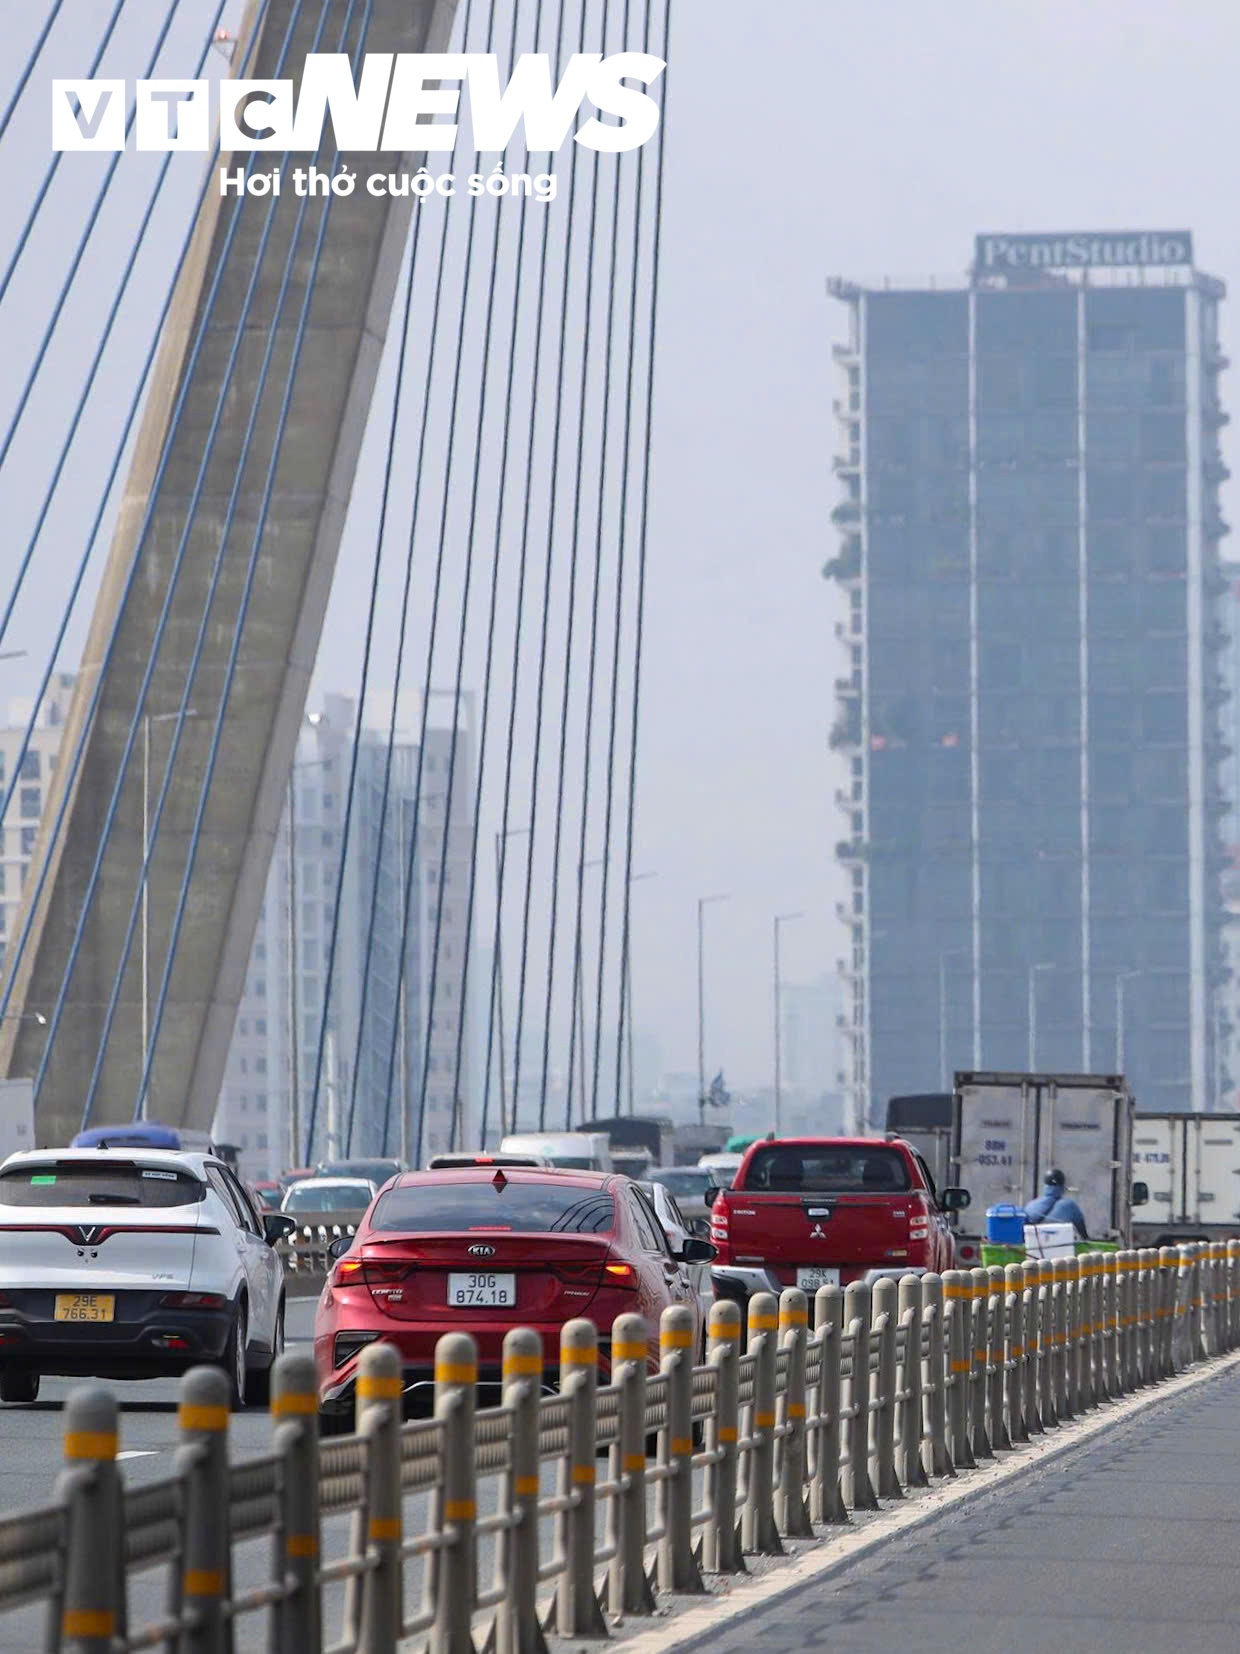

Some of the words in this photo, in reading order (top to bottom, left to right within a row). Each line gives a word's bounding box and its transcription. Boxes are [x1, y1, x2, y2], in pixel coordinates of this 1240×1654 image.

[983, 233, 1186, 266] PentStudio
[472, 1246, 491, 1256] KIA
[468, 1275, 496, 1289] 30G
[73, 1295, 98, 1307] 29E
[456, 1290, 508, 1304] 874.18
[63, 1308, 106, 1320] 766.31
